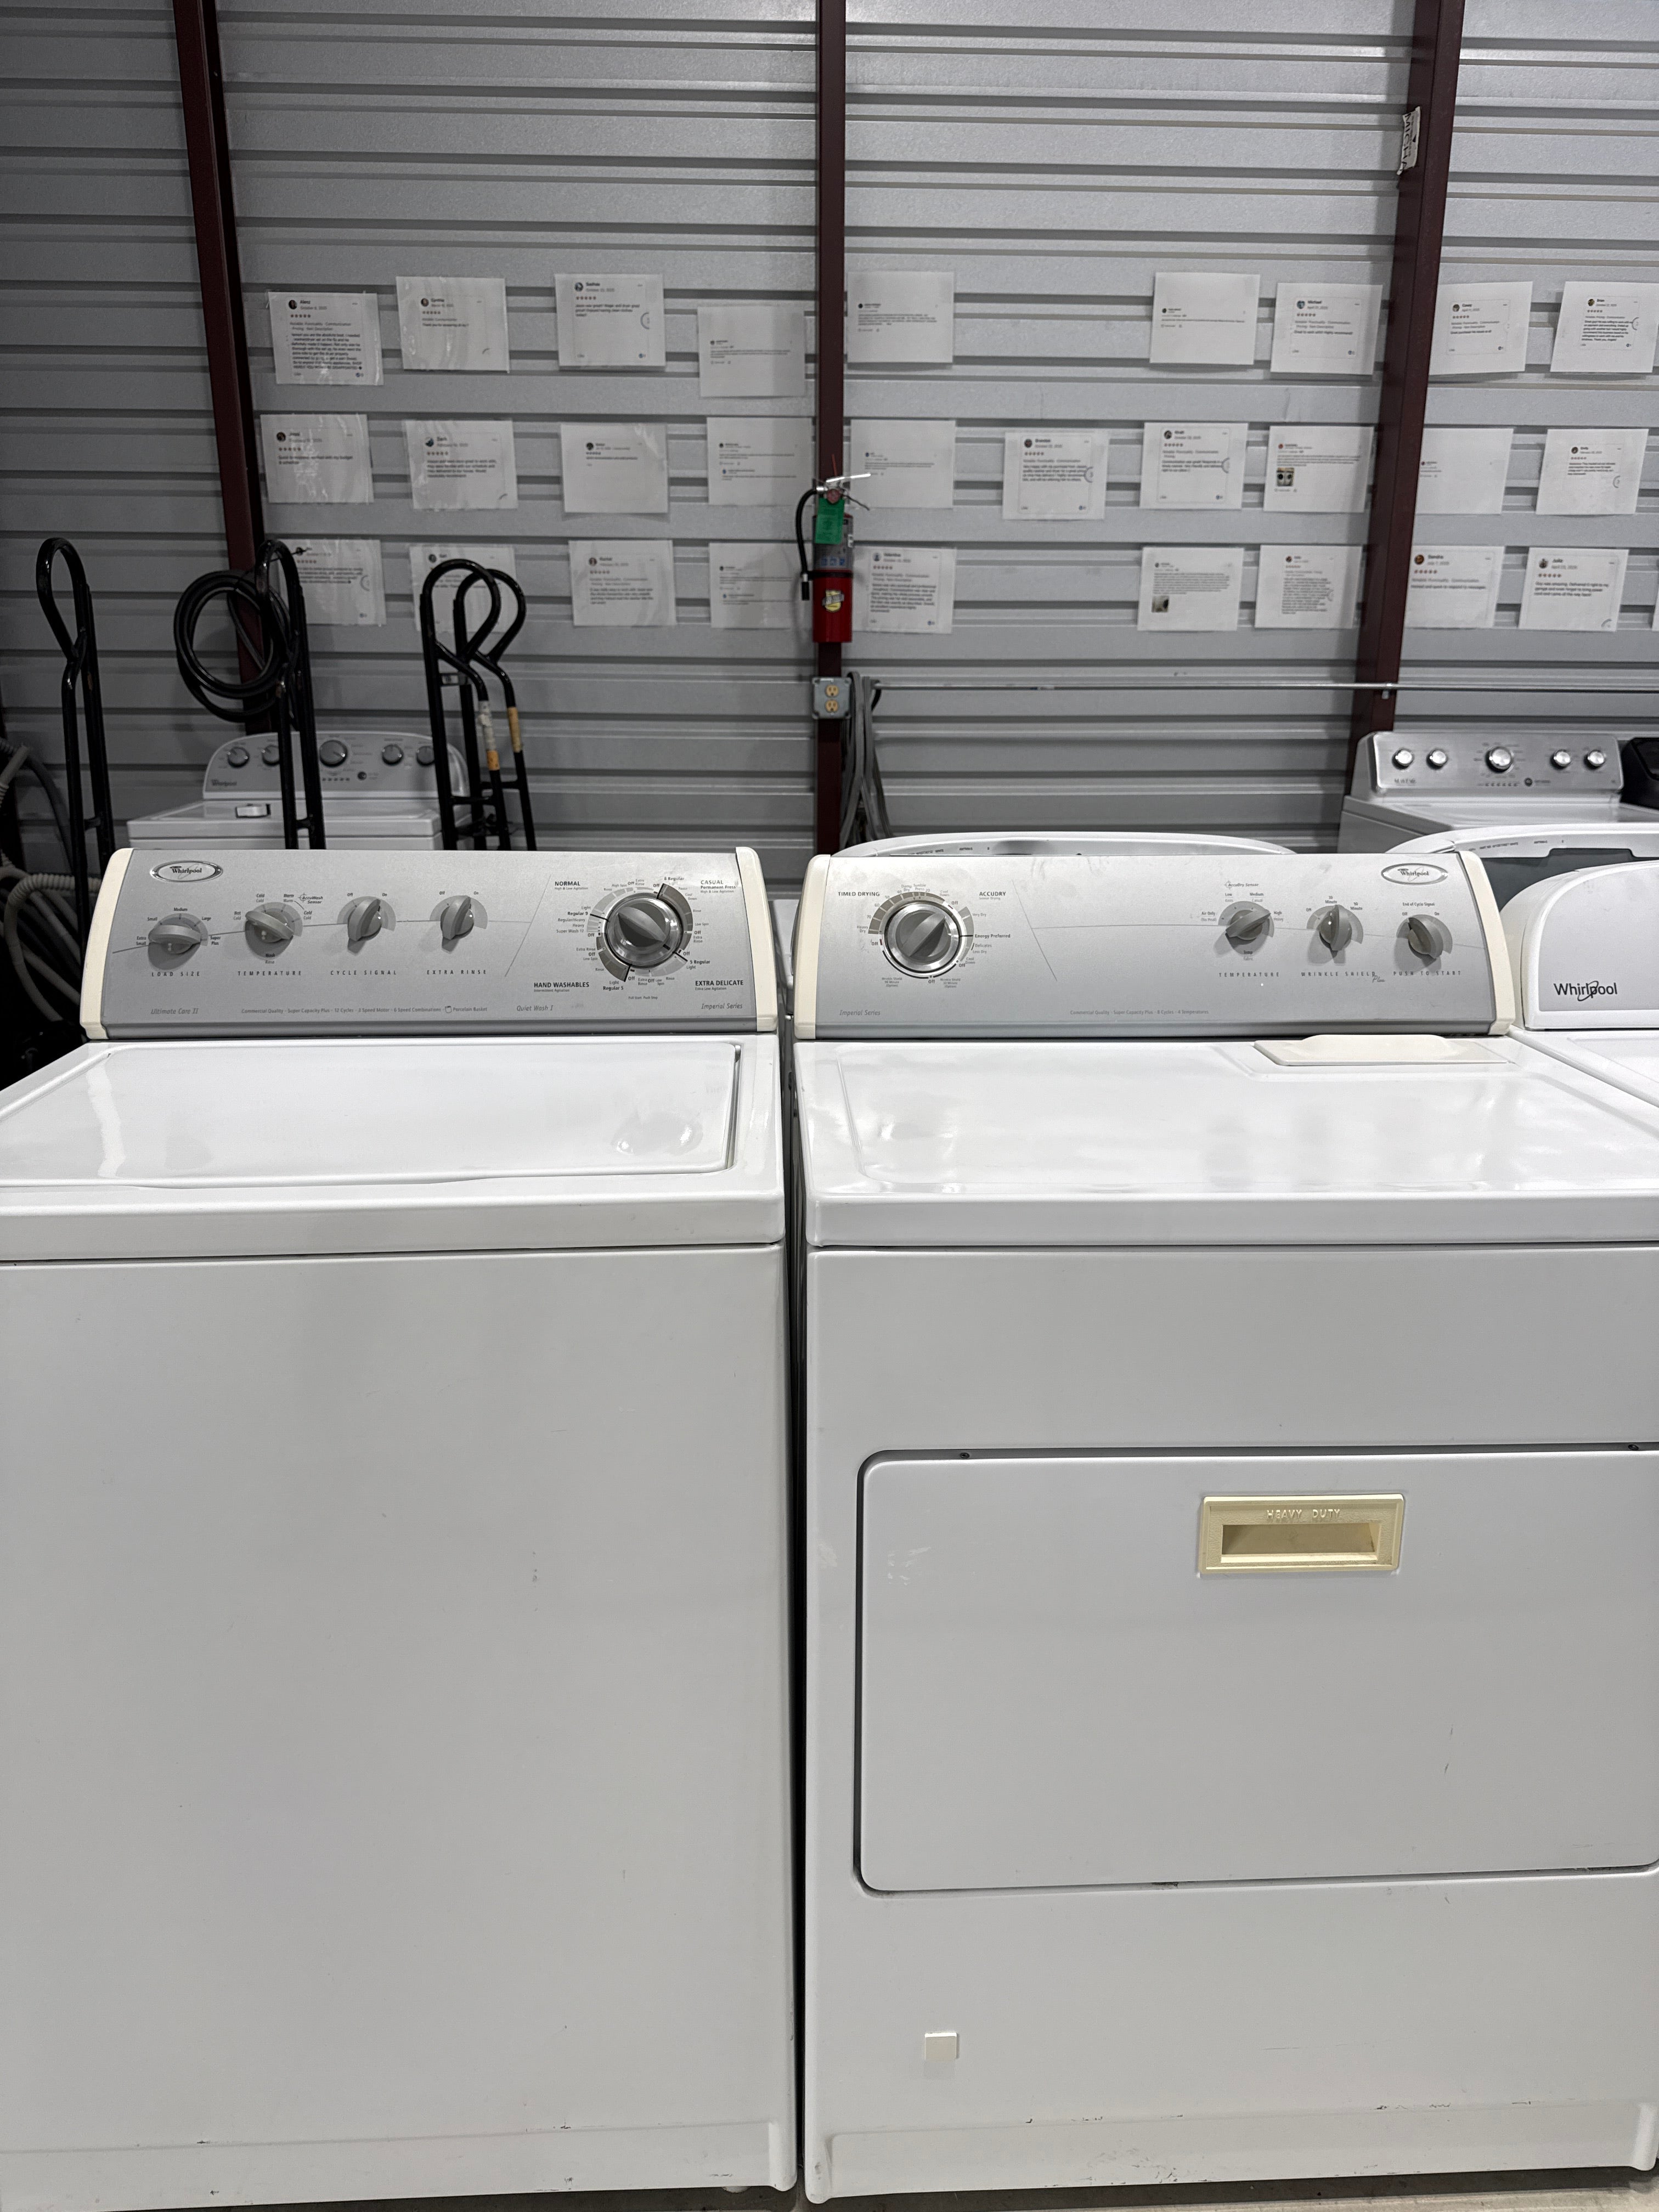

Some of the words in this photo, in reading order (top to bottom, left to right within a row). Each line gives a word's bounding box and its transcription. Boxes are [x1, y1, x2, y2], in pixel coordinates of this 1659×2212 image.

[1553, 981, 1617, 1000] Whirlpool
[1267, 1509, 1302, 1519] HEAVY
[1312, 1509, 1340, 1518] DUTY
